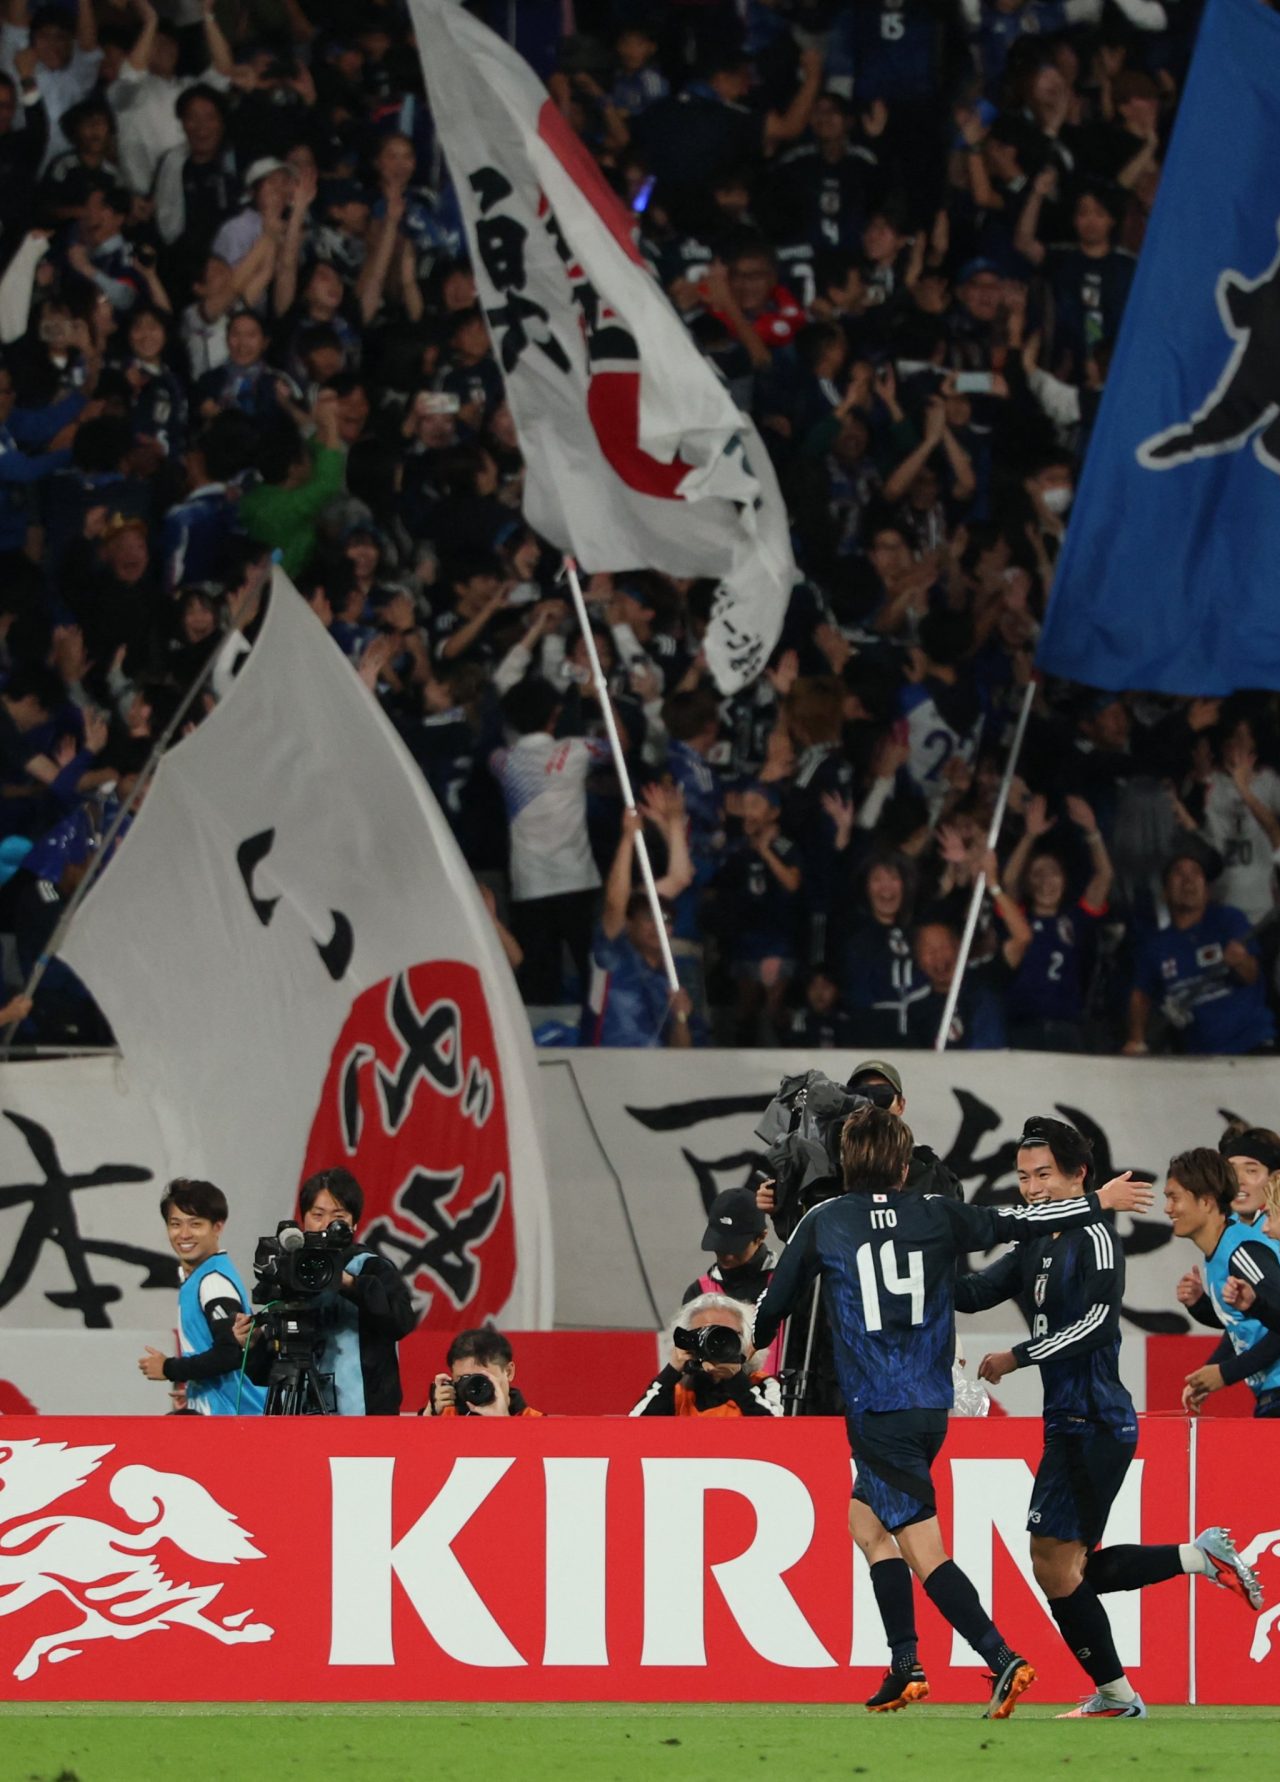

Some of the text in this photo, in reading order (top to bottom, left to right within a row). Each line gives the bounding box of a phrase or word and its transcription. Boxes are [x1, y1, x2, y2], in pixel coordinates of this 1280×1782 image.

[1048, 951, 1065, 981] 2
[870, 1208, 898, 1230] ITO
[855, 1239, 925, 1333] 14
